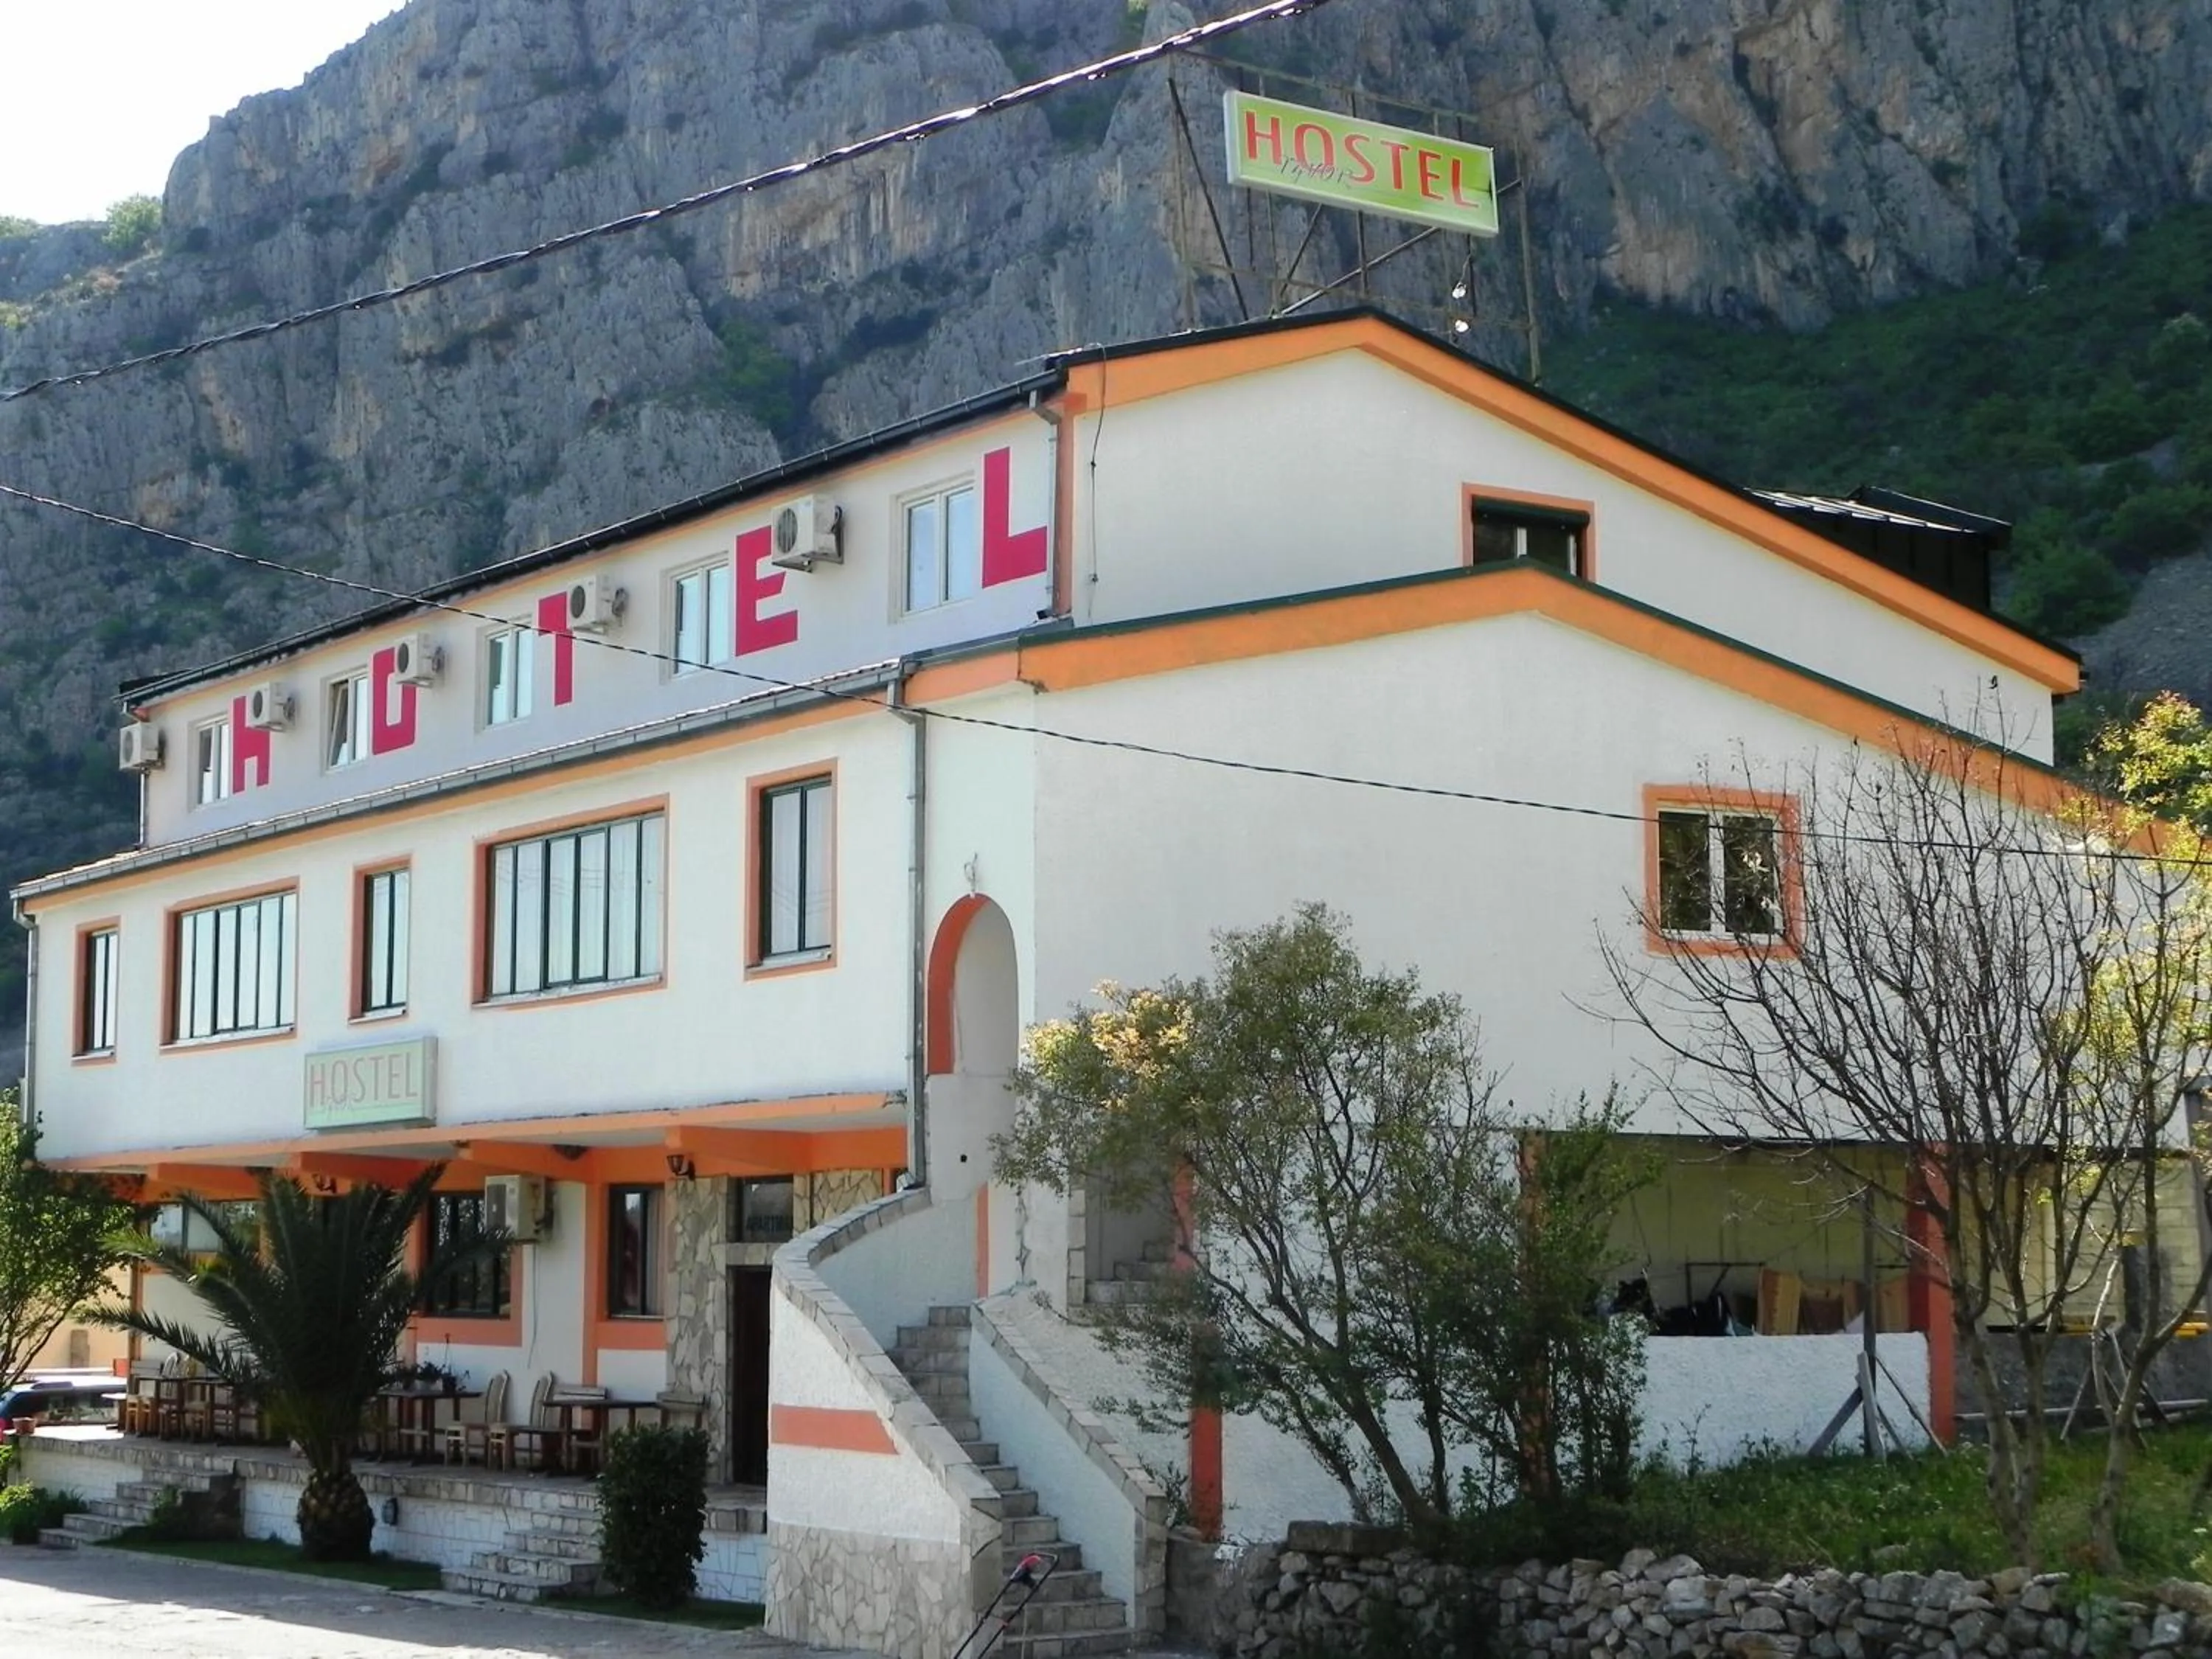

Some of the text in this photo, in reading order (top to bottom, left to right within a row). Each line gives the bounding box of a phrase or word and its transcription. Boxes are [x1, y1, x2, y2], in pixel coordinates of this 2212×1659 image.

[1244, 109, 1479, 209] HOSTEL
[232, 446, 1048, 795] HOTEL
[309, 1051, 418, 1108] HOSTEL
